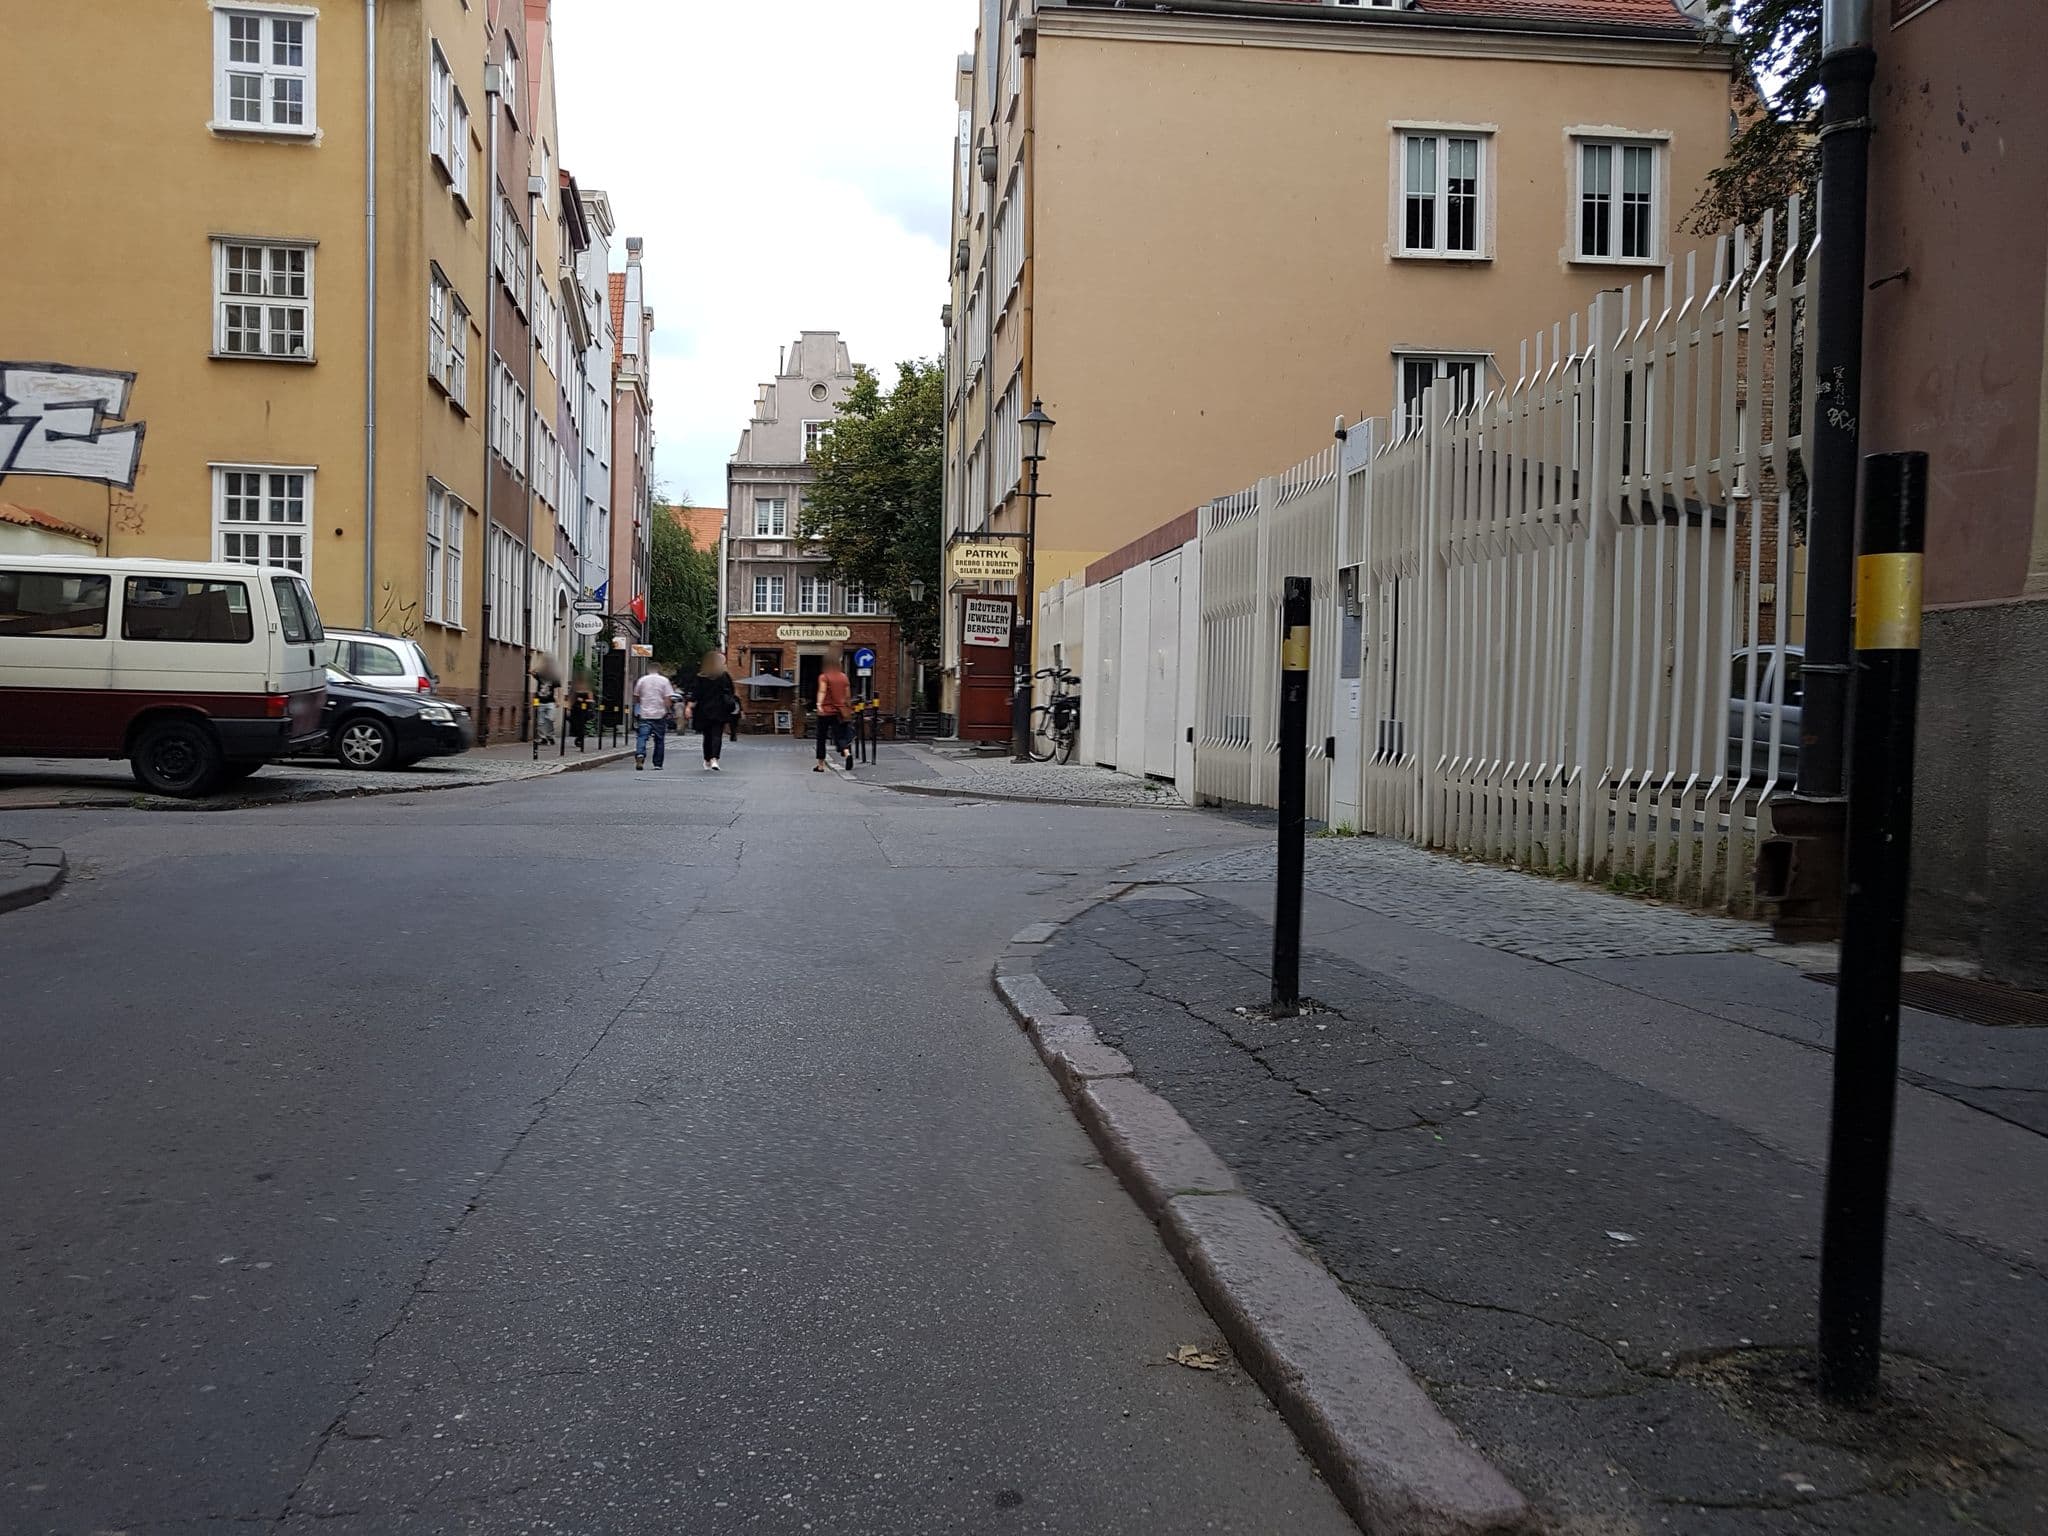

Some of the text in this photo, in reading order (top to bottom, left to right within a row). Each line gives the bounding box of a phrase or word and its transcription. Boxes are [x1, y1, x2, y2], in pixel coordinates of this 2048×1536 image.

[965, 549, 1008, 558] PATRYK
[967, 613, 1010, 624] JEWELLERY
[780, 629, 848, 638] KAFFE PERRO NEGRO
[967, 624, 1008, 635] BERNSTEIN
